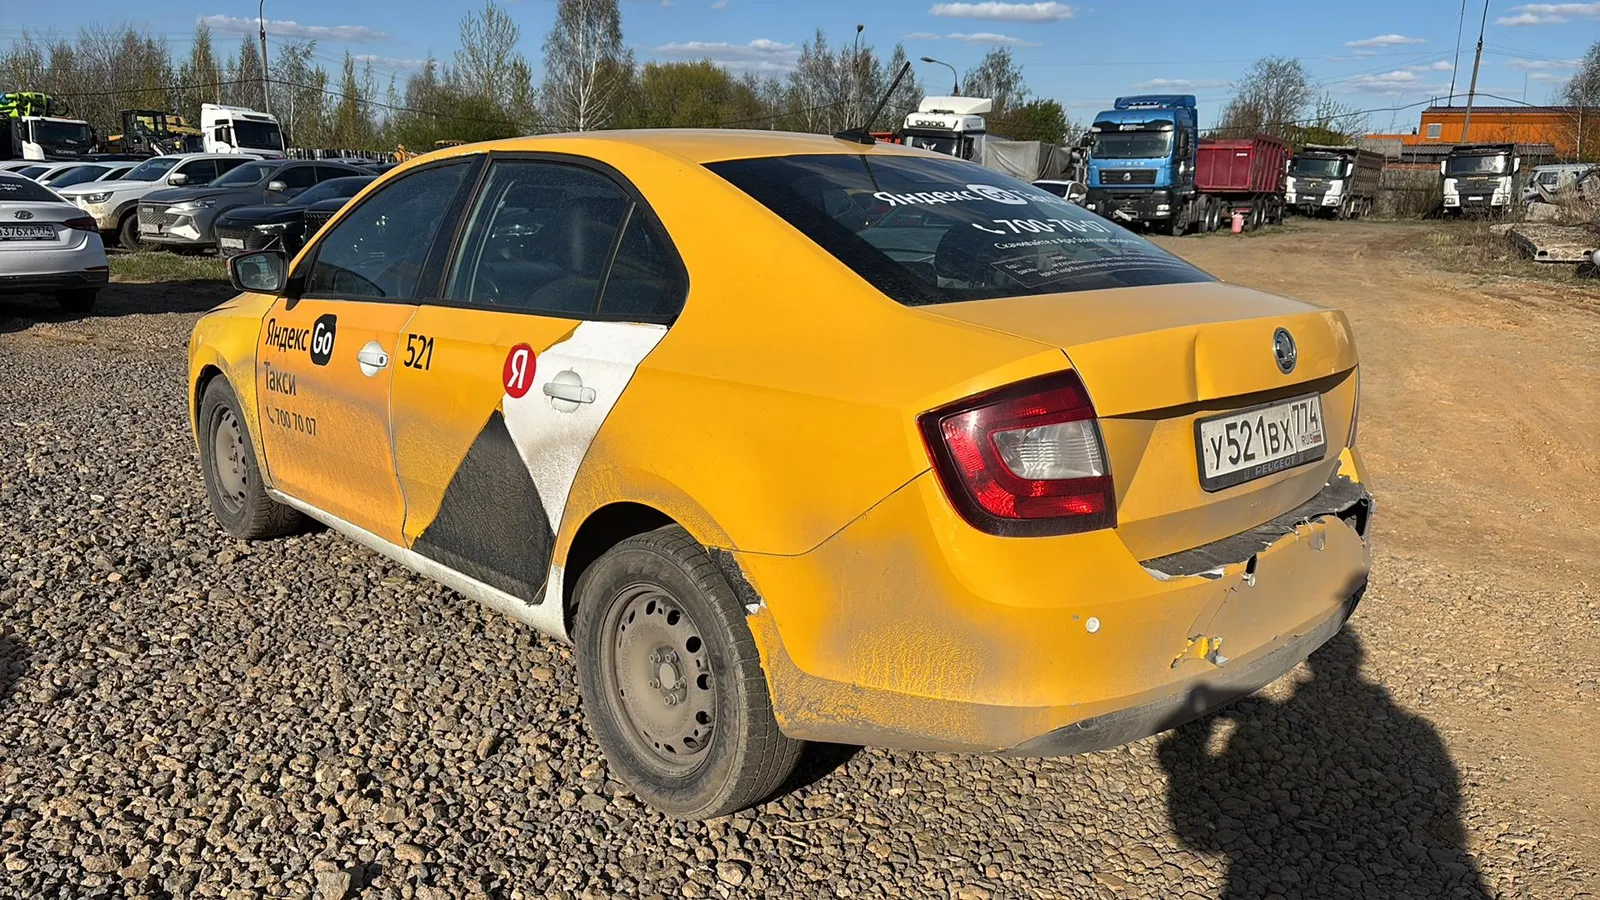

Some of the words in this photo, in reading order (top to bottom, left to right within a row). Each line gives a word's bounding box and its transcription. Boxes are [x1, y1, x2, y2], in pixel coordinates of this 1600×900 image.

[873, 190, 982, 206] Яндекс
[992, 219, 1111, 234] 700-70-07
[265, 318, 310, 352] Яндекс
[312, 322, 333, 356] Go
[403, 333, 434, 370] 521
[263, 361, 297, 396] Такси
[506, 348, 529, 390] Я
[275, 408, 292, 429] 700
[292, 413, 304, 433] 70
[305, 416, 316, 437] 07
[1291, 400, 1318, 436] 774
[1301, 433, 1314, 447] RUS
[1255, 455, 1296, 477] PEUGEOT
